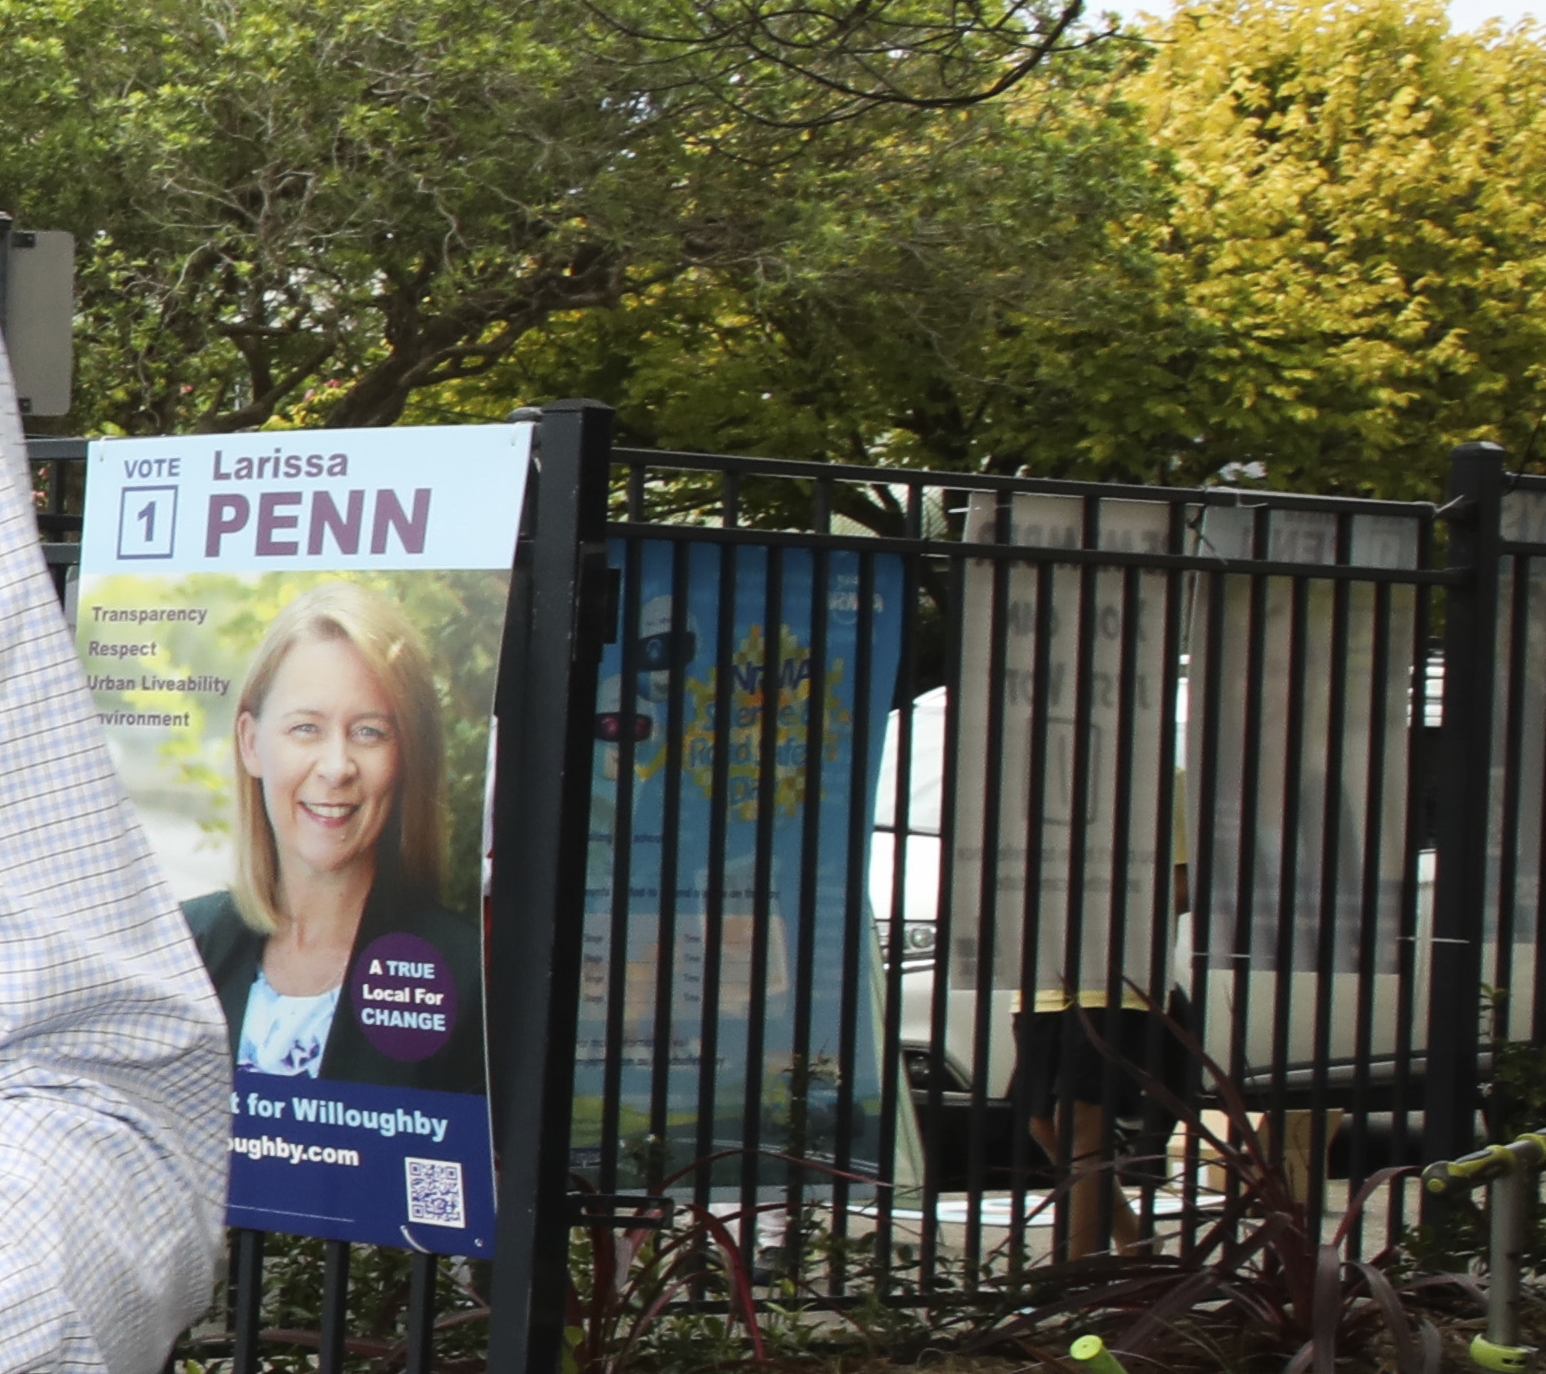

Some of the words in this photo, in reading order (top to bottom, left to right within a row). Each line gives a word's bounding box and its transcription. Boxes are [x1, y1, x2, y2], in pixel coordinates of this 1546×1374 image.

[124, 457, 182, 479] VOTE
[213, 448, 349, 481] Larissa
[137, 500, 157, 543] 1
[204, 488, 432, 558] PENN
[92, 606, 207, 625] Transparency
[89, 641, 157, 659] Respect
[88, 673, 136, 691] Urban
[141, 675, 231, 696] Liveability
[98, 711, 190, 727] nvironment
[369, 960, 383, 975] A
[387, 960, 435, 978] TRUE
[362, 984, 410, 1002] Local
[415, 988, 444, 1005] For
[361, 1008, 446, 1031] CHANGE
[247, 1093, 285, 1118] for
[292, 1097, 448, 1142] Willoughby
